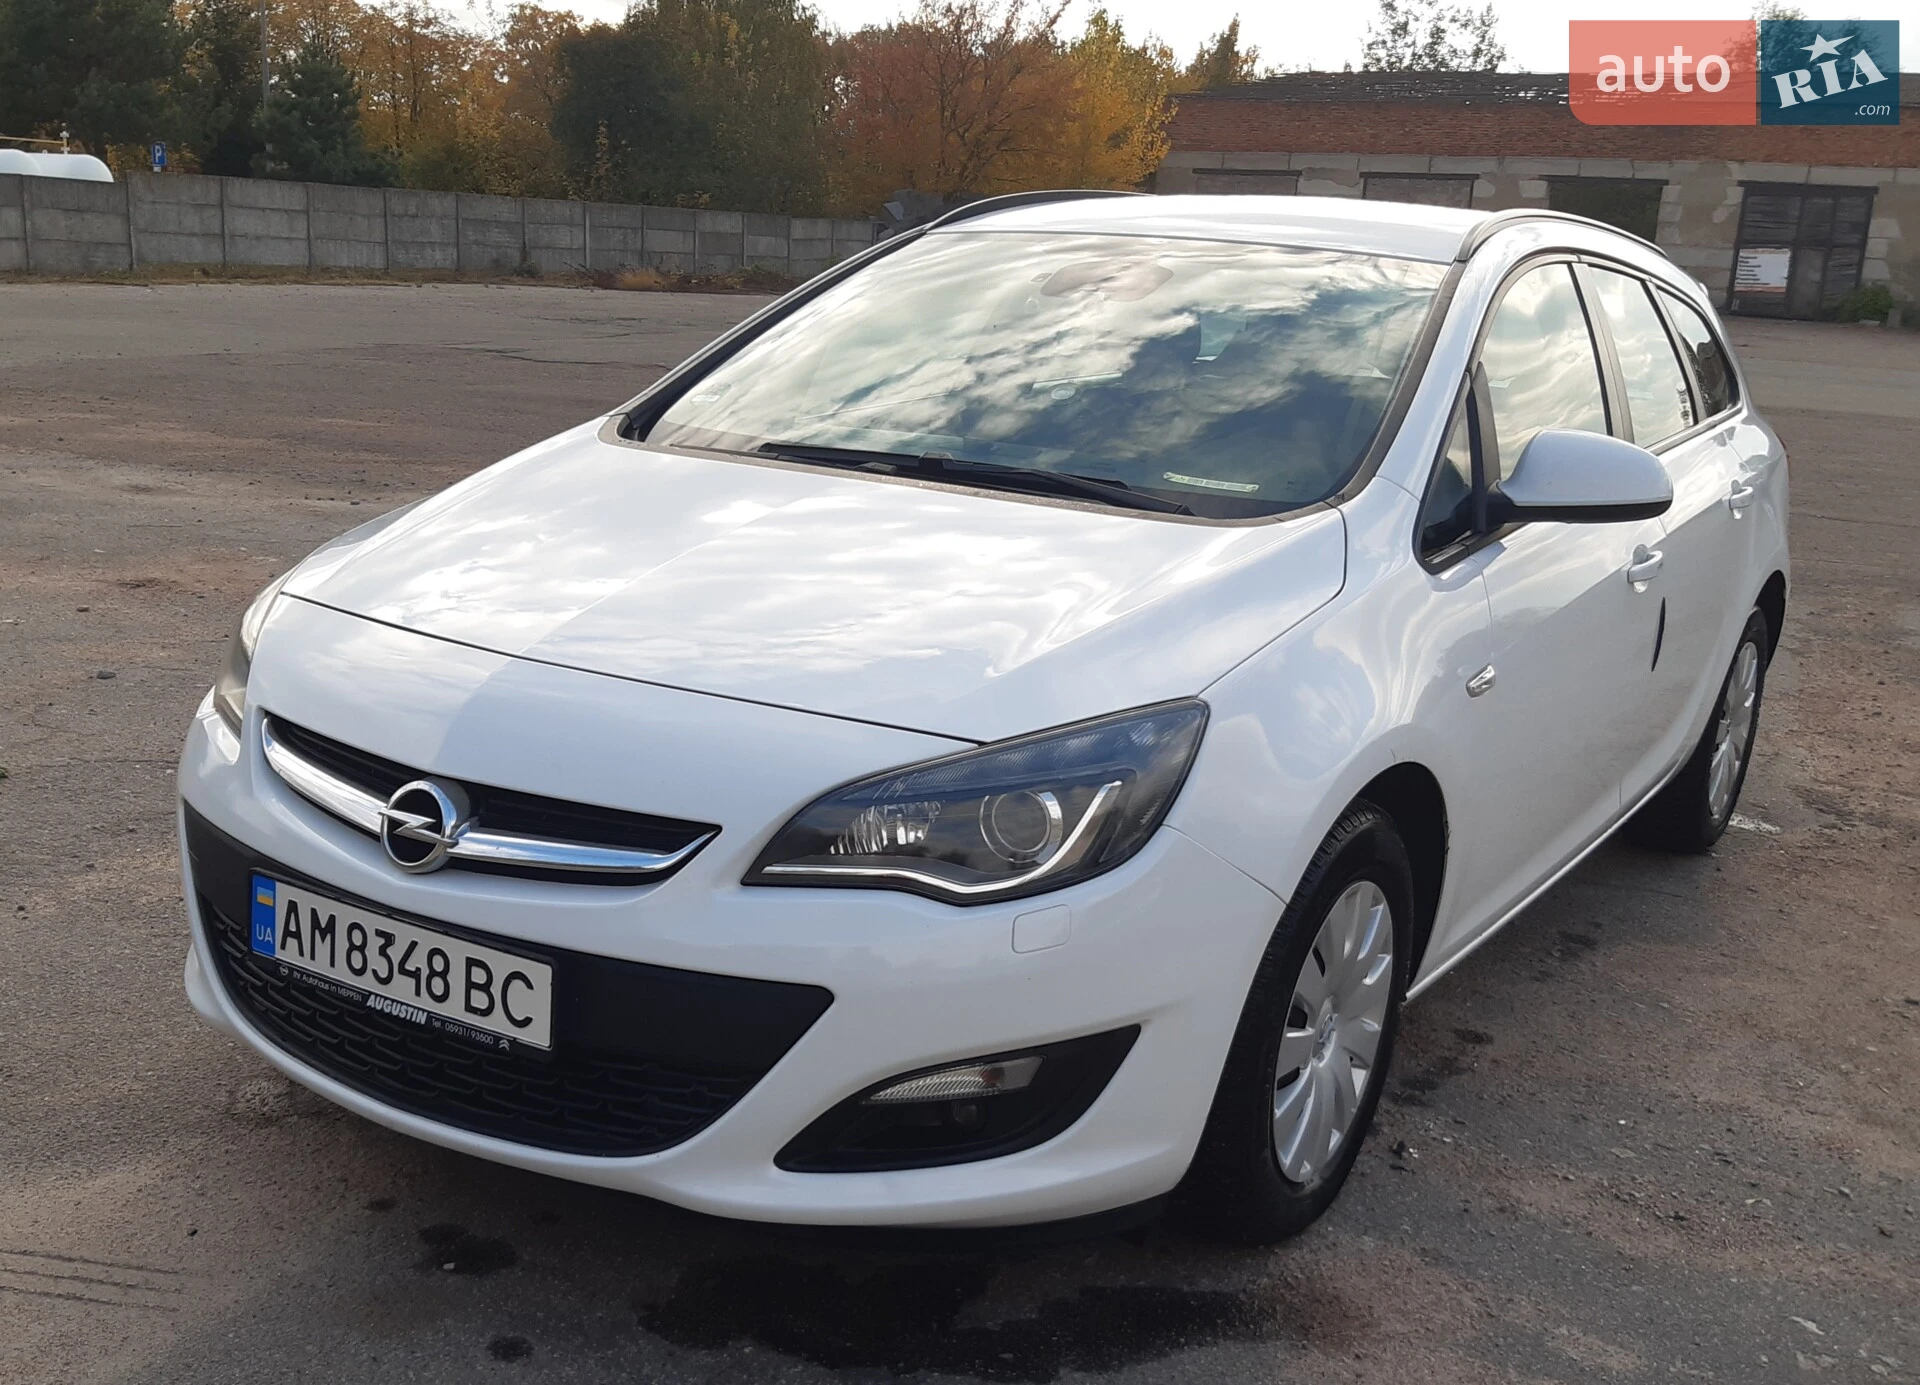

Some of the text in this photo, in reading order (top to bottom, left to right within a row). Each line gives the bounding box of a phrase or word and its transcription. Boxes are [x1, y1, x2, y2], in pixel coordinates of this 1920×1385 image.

[154, 145, 162, 163] P
[256, 923, 274, 944] UA
[280, 898, 534, 1029] AM 8348 BC
[366, 994, 428, 1026] AUGUSTIN
